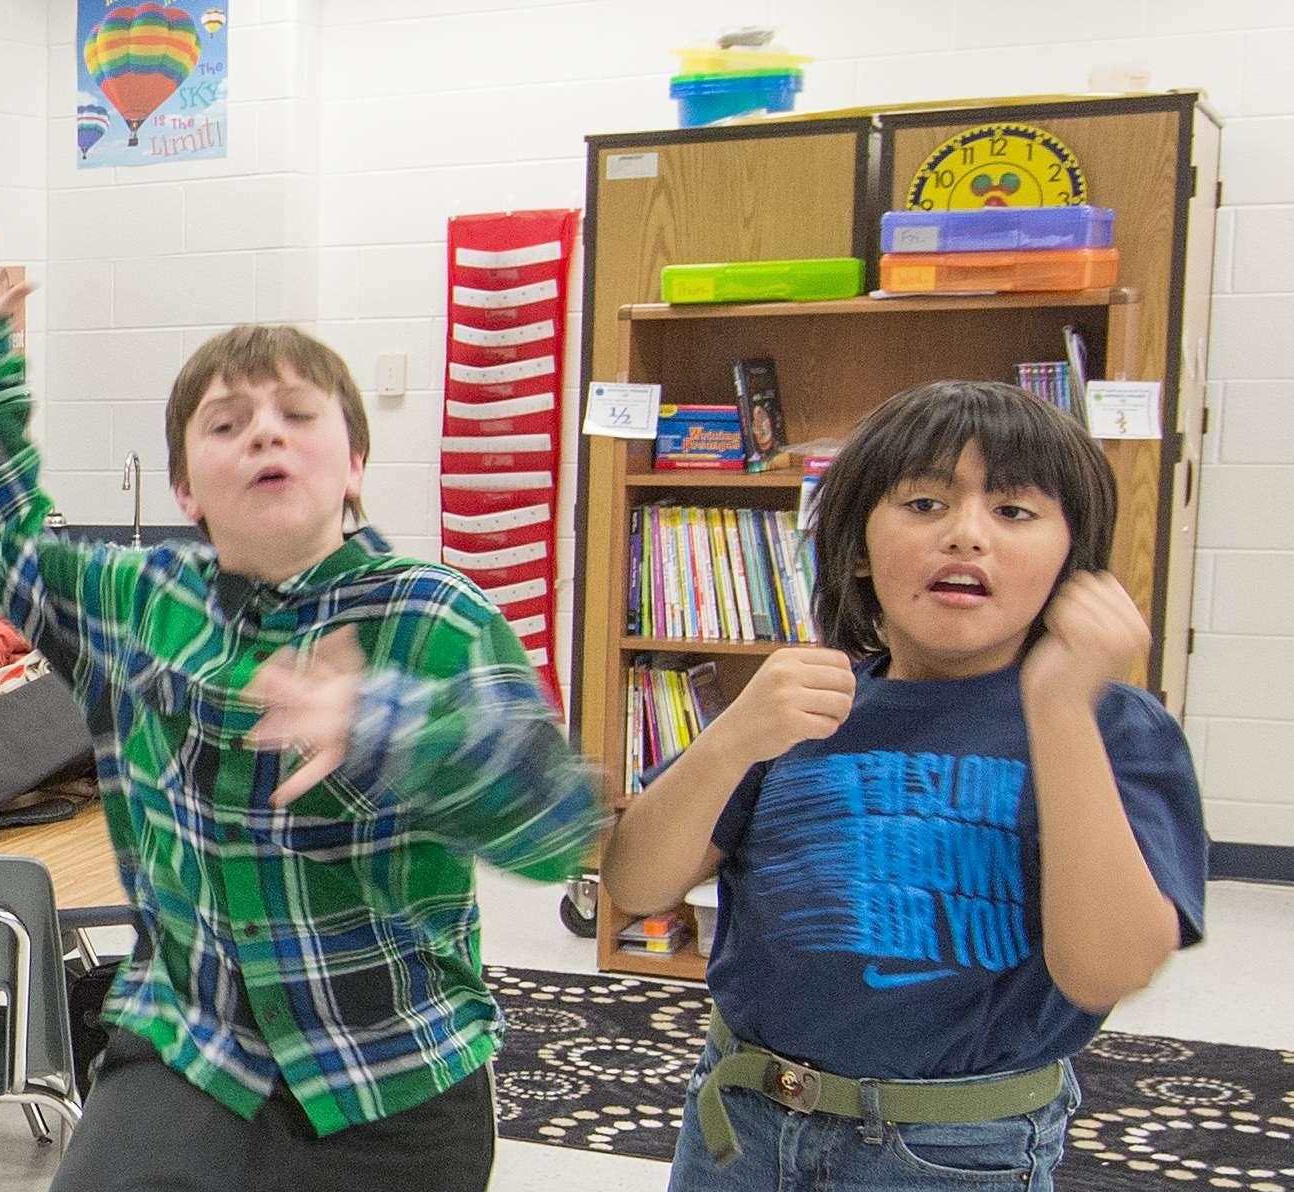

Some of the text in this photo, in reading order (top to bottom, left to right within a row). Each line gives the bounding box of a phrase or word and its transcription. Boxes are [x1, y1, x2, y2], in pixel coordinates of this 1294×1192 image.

[197, 62, 224, 75] The
[962, 147, 975, 165] 11
[989, 137, 1009, 157] 12
[1027, 143, 1034, 161] 1
[934, 169, 955, 189] 10
[1048, 164, 1063, 183] 2
[942, 891, 1032, 974] YOU
